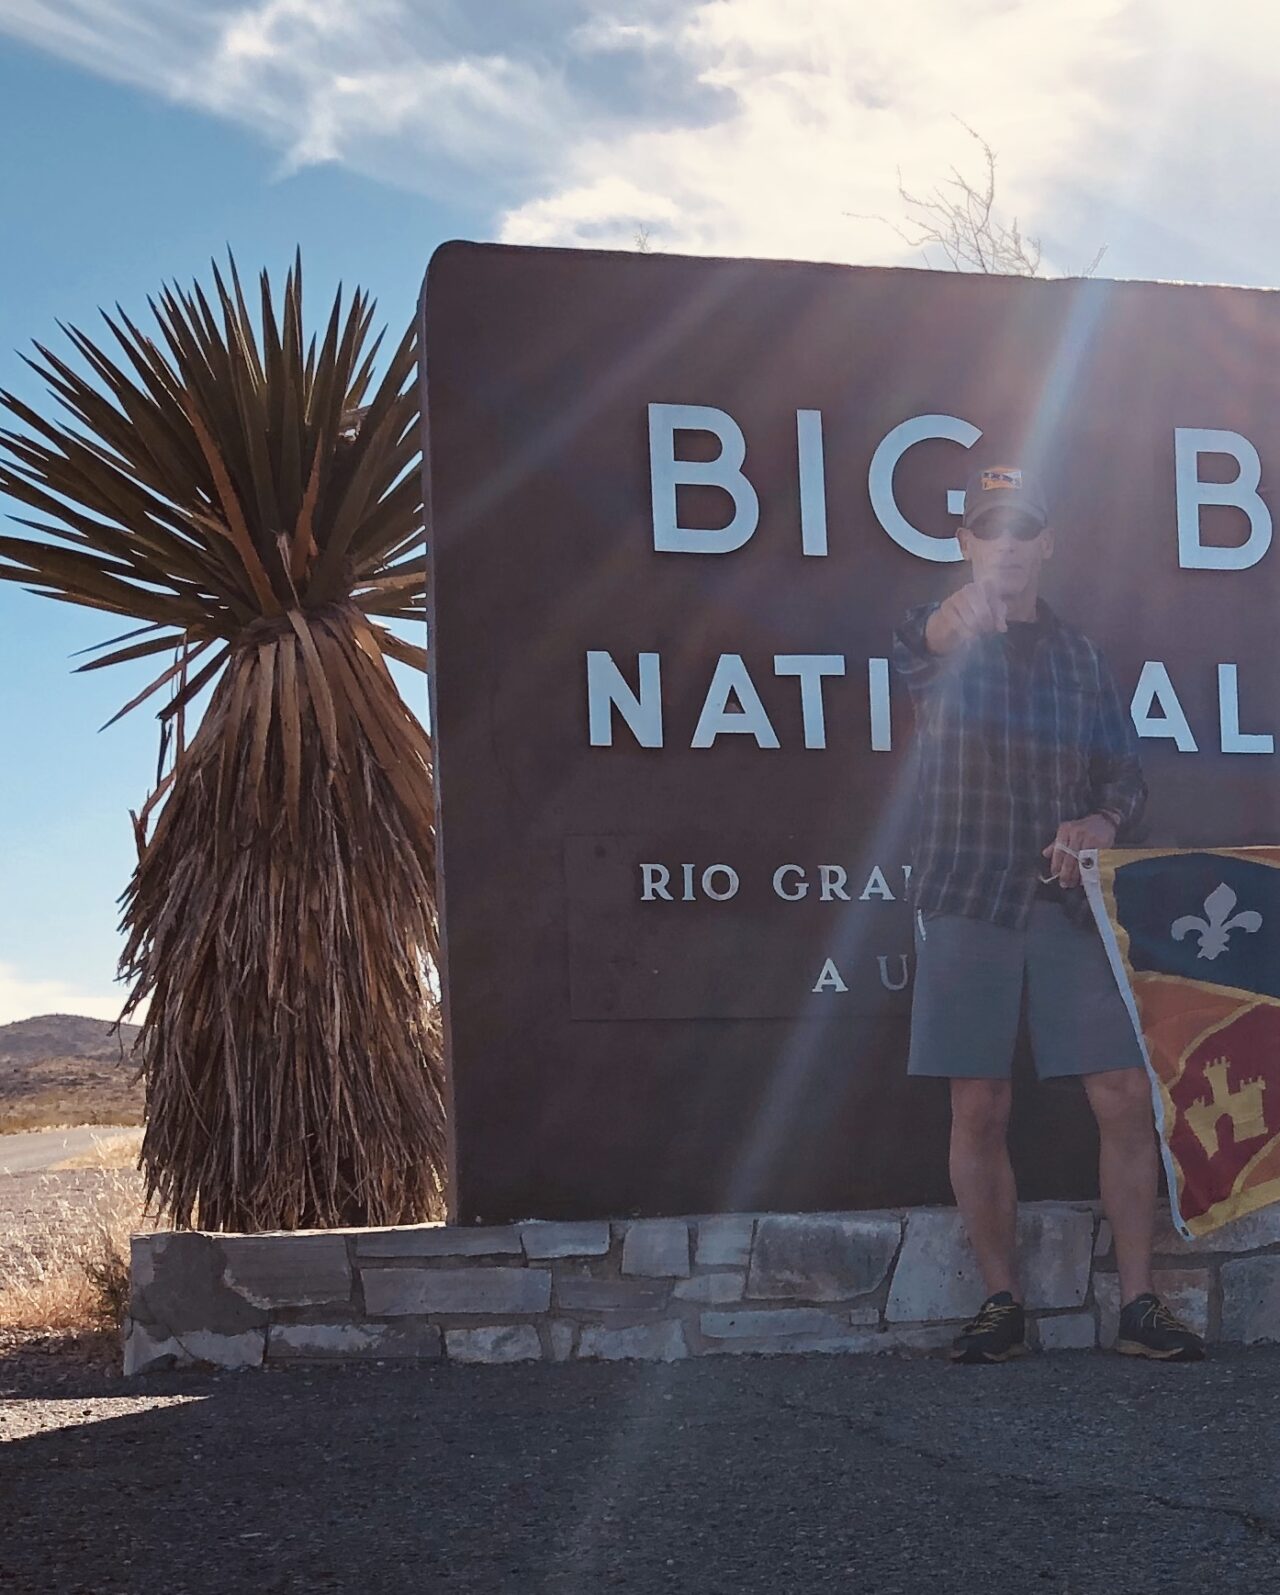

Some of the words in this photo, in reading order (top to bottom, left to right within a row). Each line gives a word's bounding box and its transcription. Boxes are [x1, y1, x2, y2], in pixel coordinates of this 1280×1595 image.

[648, 403, 983, 563] BIG
[586, 651, 1275, 754] NATIAL
[640, 863, 740, 901] RIO
[772, 864, 913, 901] GRA
[812, 957, 849, 993] A
